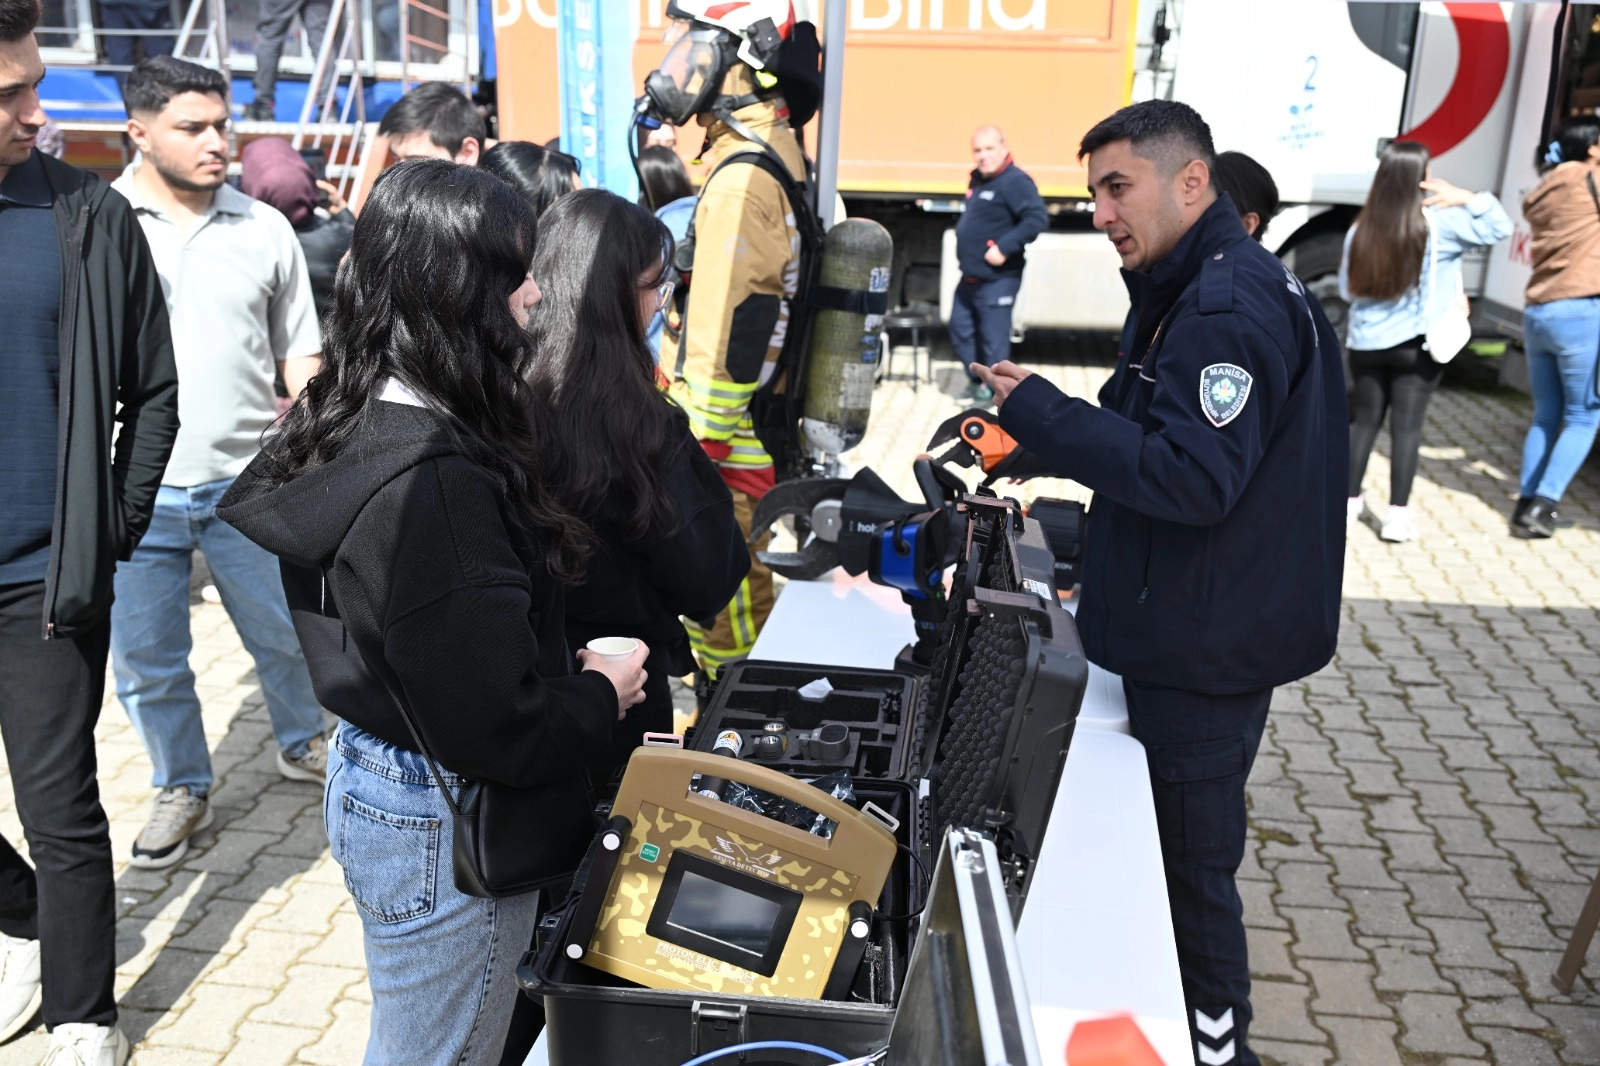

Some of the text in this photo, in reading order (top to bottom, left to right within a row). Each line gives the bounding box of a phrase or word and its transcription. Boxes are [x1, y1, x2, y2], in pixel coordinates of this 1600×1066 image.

[1304, 55, 1318, 92] 2
[1209, 368, 1247, 382] MANİSA
[736, 862, 770, 878] DETECTOR
[657, 941, 695, 960] PROTON
